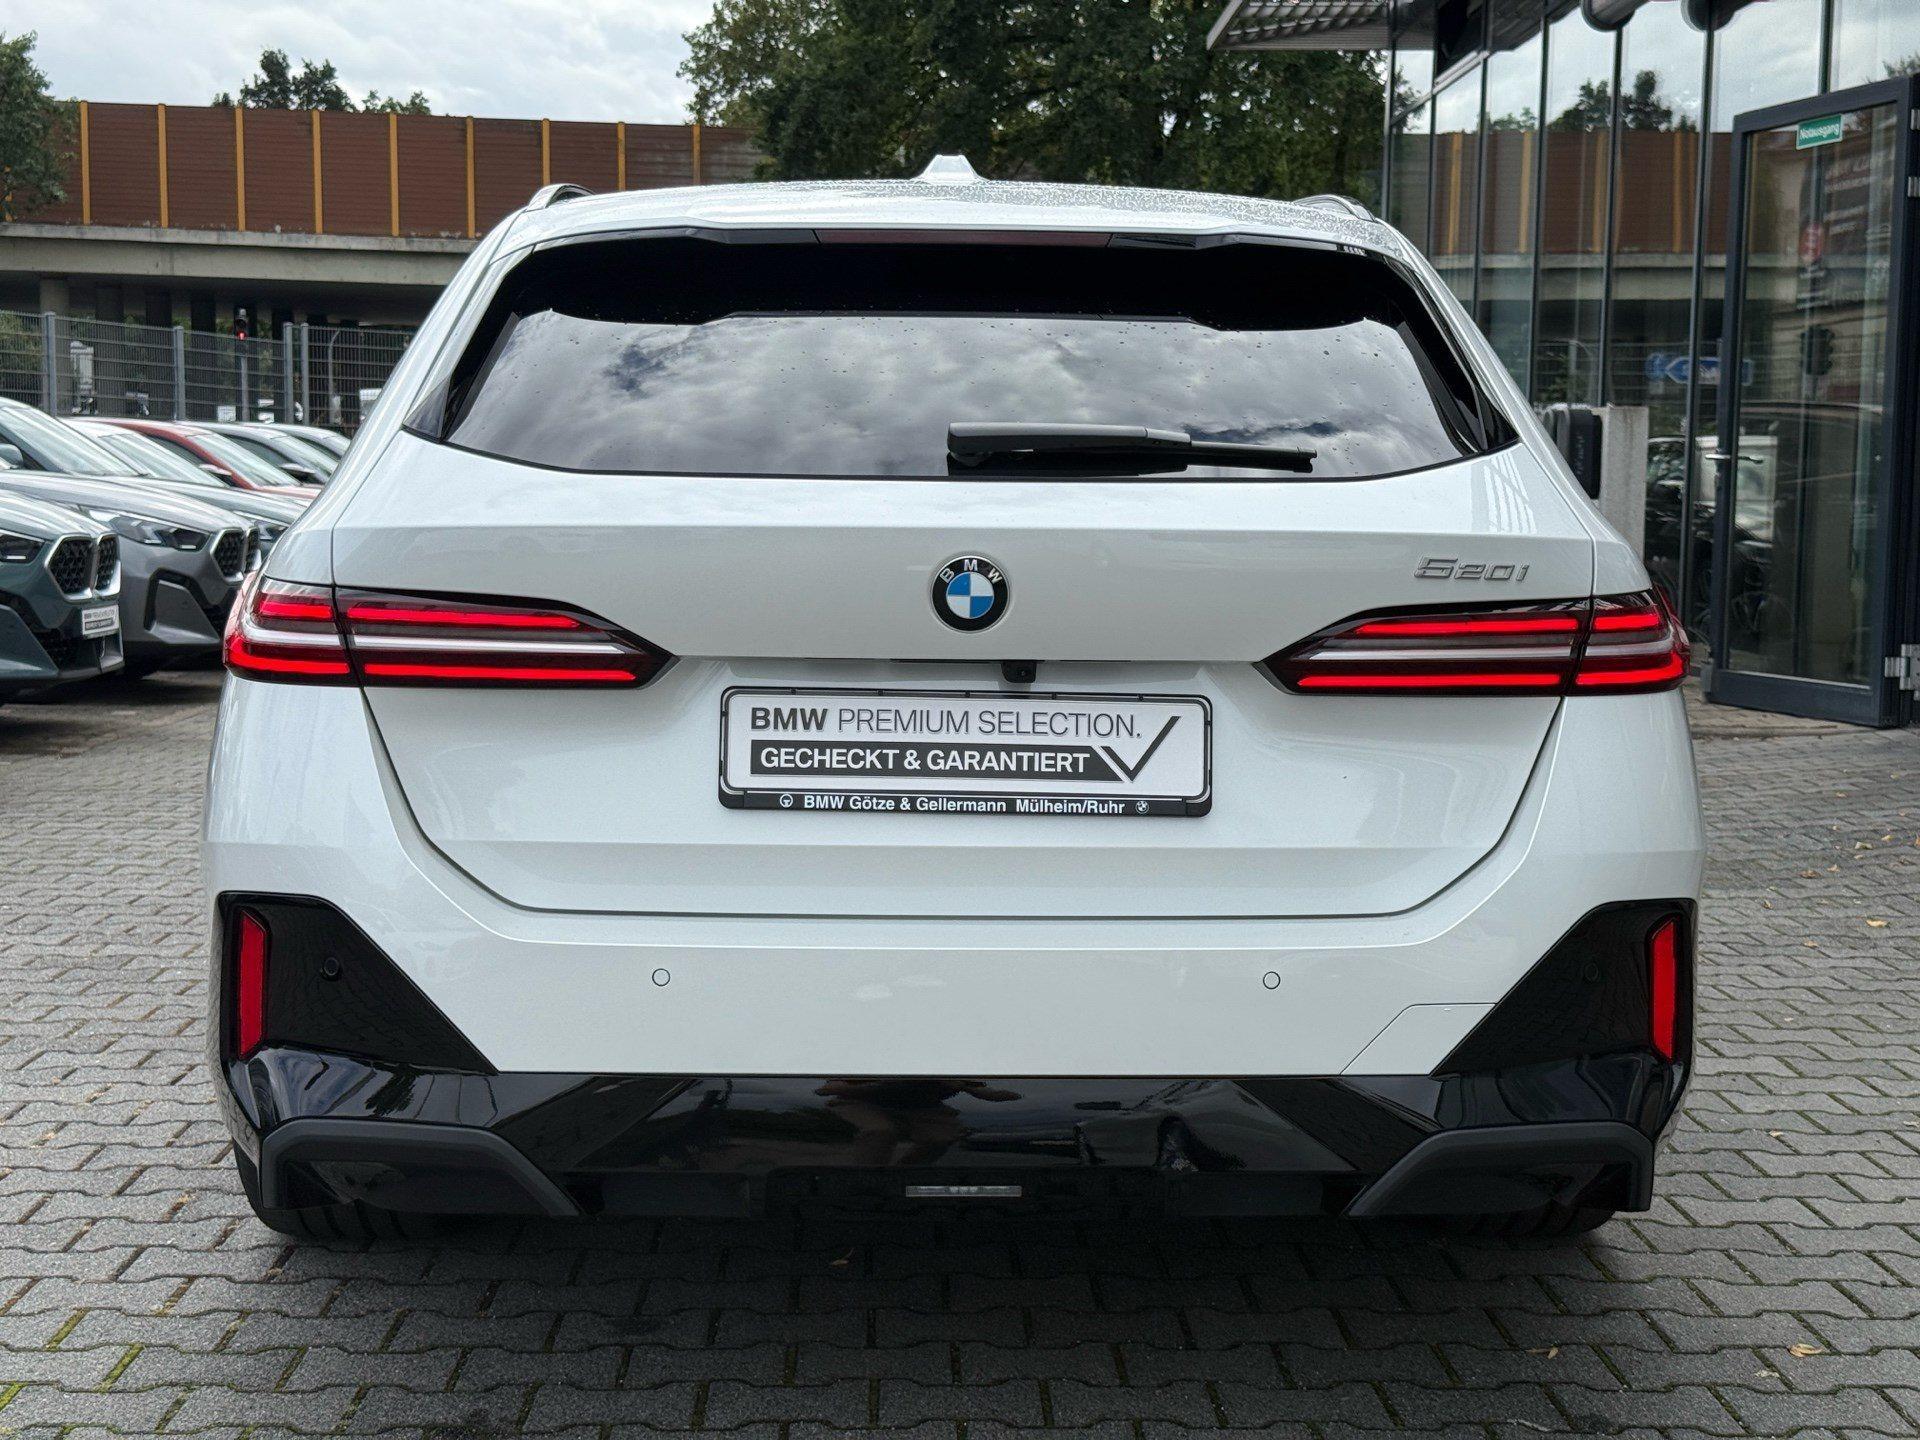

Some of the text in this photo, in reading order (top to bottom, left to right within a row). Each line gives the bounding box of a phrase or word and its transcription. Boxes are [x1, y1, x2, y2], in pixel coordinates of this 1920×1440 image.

[939, 558, 1003, 584] BMW
[1414, 556, 1530, 582] 520i
[750, 706, 1142, 738] BMW PREMIUM SELECTION.
[760, 747, 1091, 774] GECHECKT & GARANTIERT
[803, 794, 1126, 815] BMW Götze & Gellermann Mülheim/Ruhr
